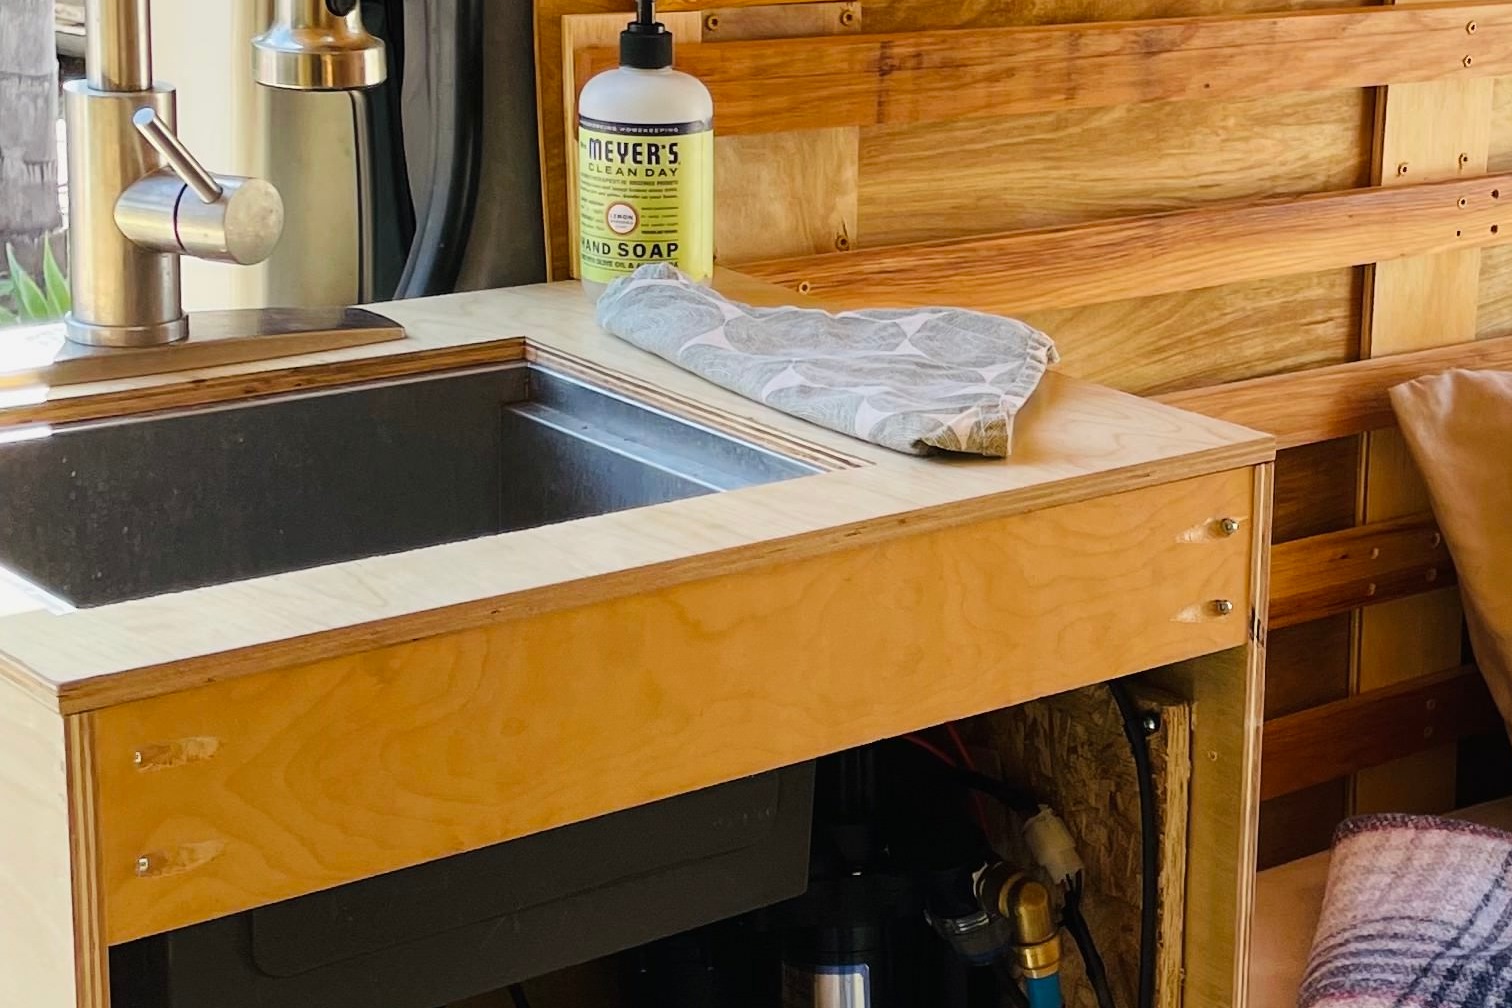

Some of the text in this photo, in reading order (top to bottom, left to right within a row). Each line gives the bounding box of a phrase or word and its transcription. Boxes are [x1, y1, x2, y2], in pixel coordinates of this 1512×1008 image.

[589, 138, 678, 164] MEYER'S
[588, 163, 677, 177] CLEAN DAY
[618, 243, 678, 258] SOAP
